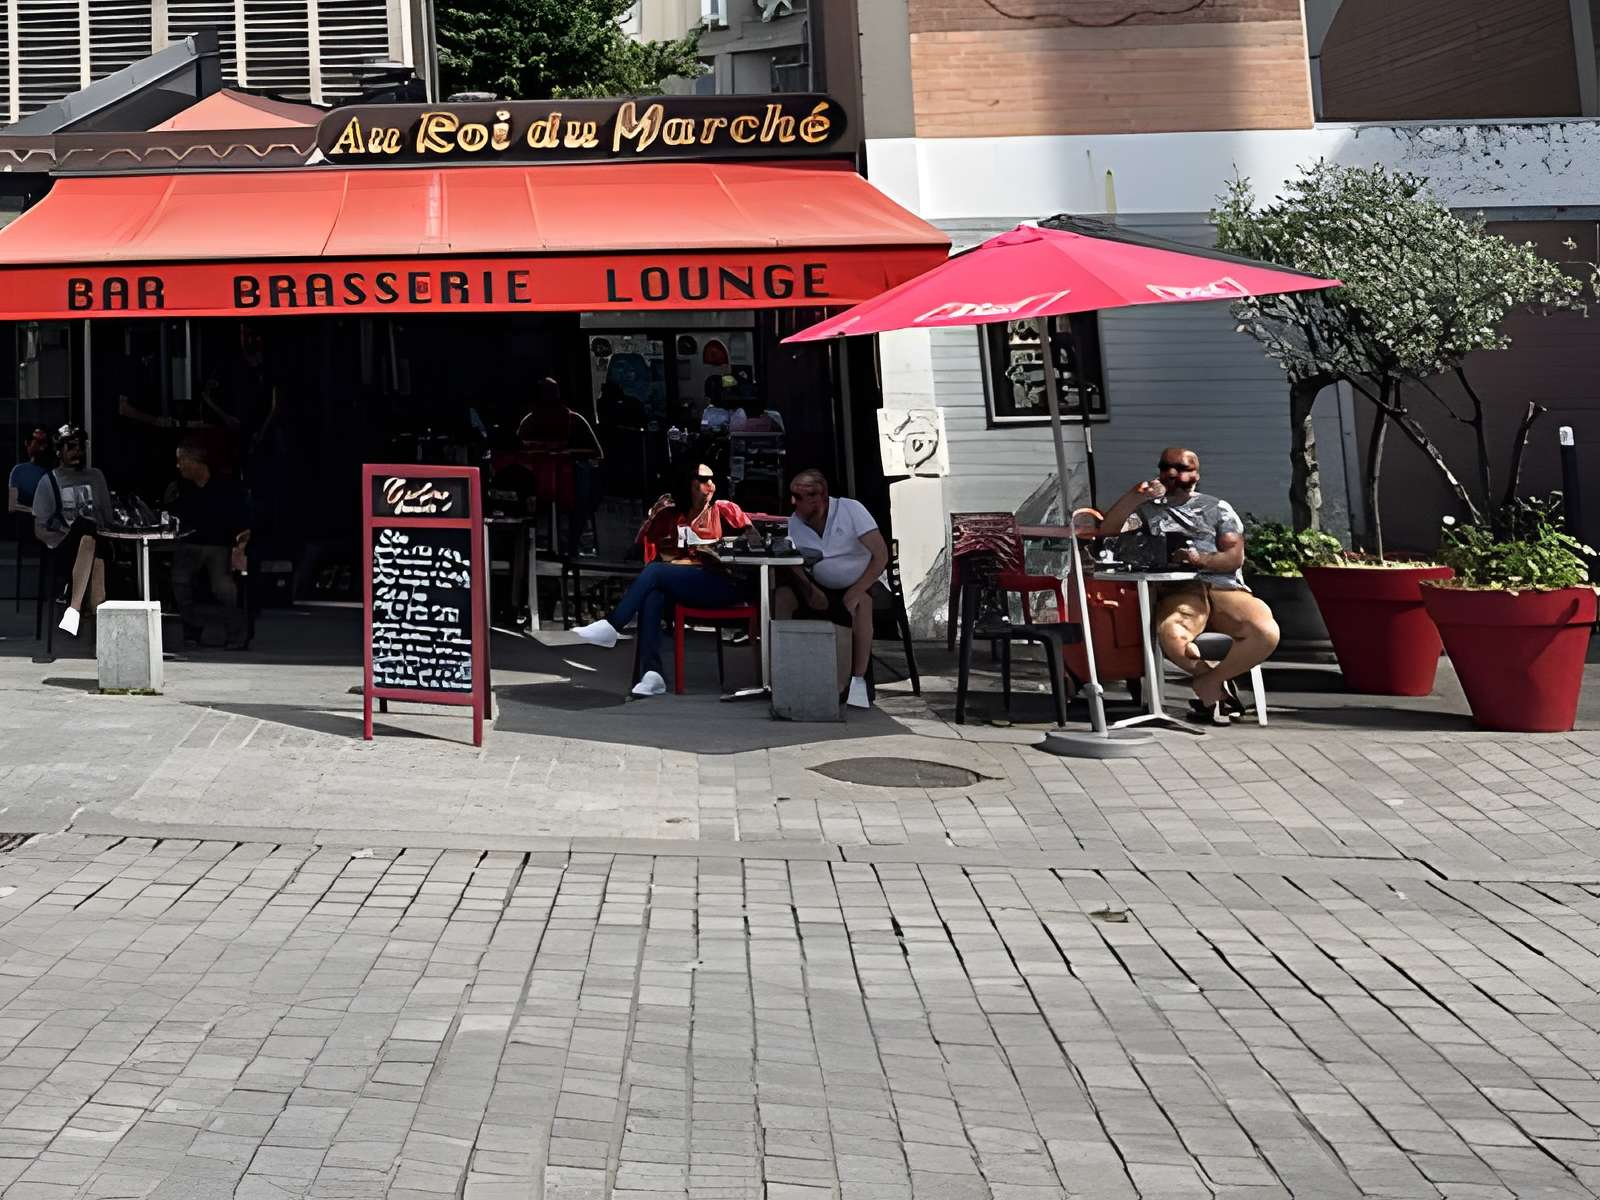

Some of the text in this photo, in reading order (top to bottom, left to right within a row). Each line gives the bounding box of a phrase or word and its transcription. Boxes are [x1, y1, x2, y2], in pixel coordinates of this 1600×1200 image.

[329, 101, 831, 154] Au Roi du Marché
[67, 263, 831, 311] BAR BRASSERIE LOUNGE
